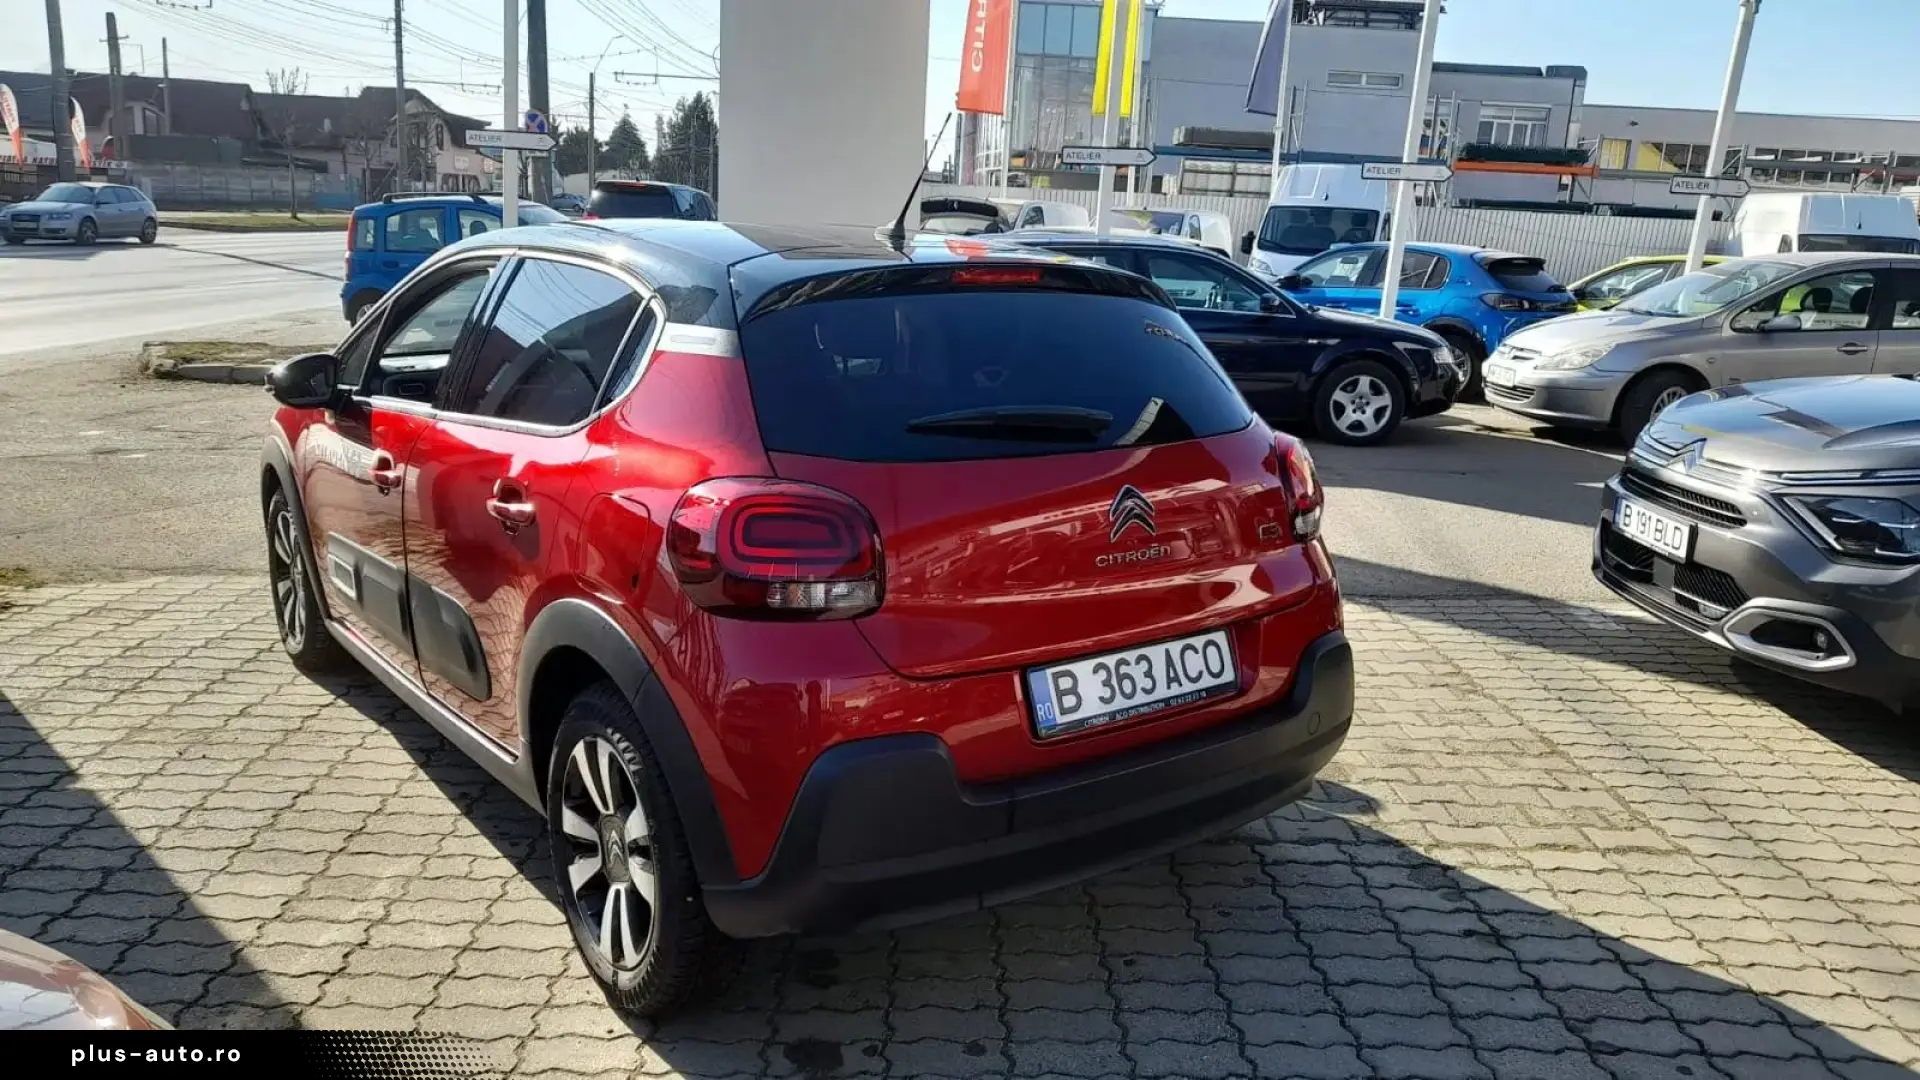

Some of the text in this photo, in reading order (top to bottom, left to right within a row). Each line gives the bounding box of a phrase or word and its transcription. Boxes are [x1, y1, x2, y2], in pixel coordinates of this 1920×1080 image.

[468, 133, 502, 143] ATELIER
[1065, 151, 1101, 160] ATELIER
[1365, 166, 1402, 175] ATELIER
[1673, 180, 1710, 190] ATELIER
[1623, 503, 1683, 550] B 191 BLD
[1051, 638, 1226, 716] B 363 ACO
[1036, 702, 1054, 722] RO
